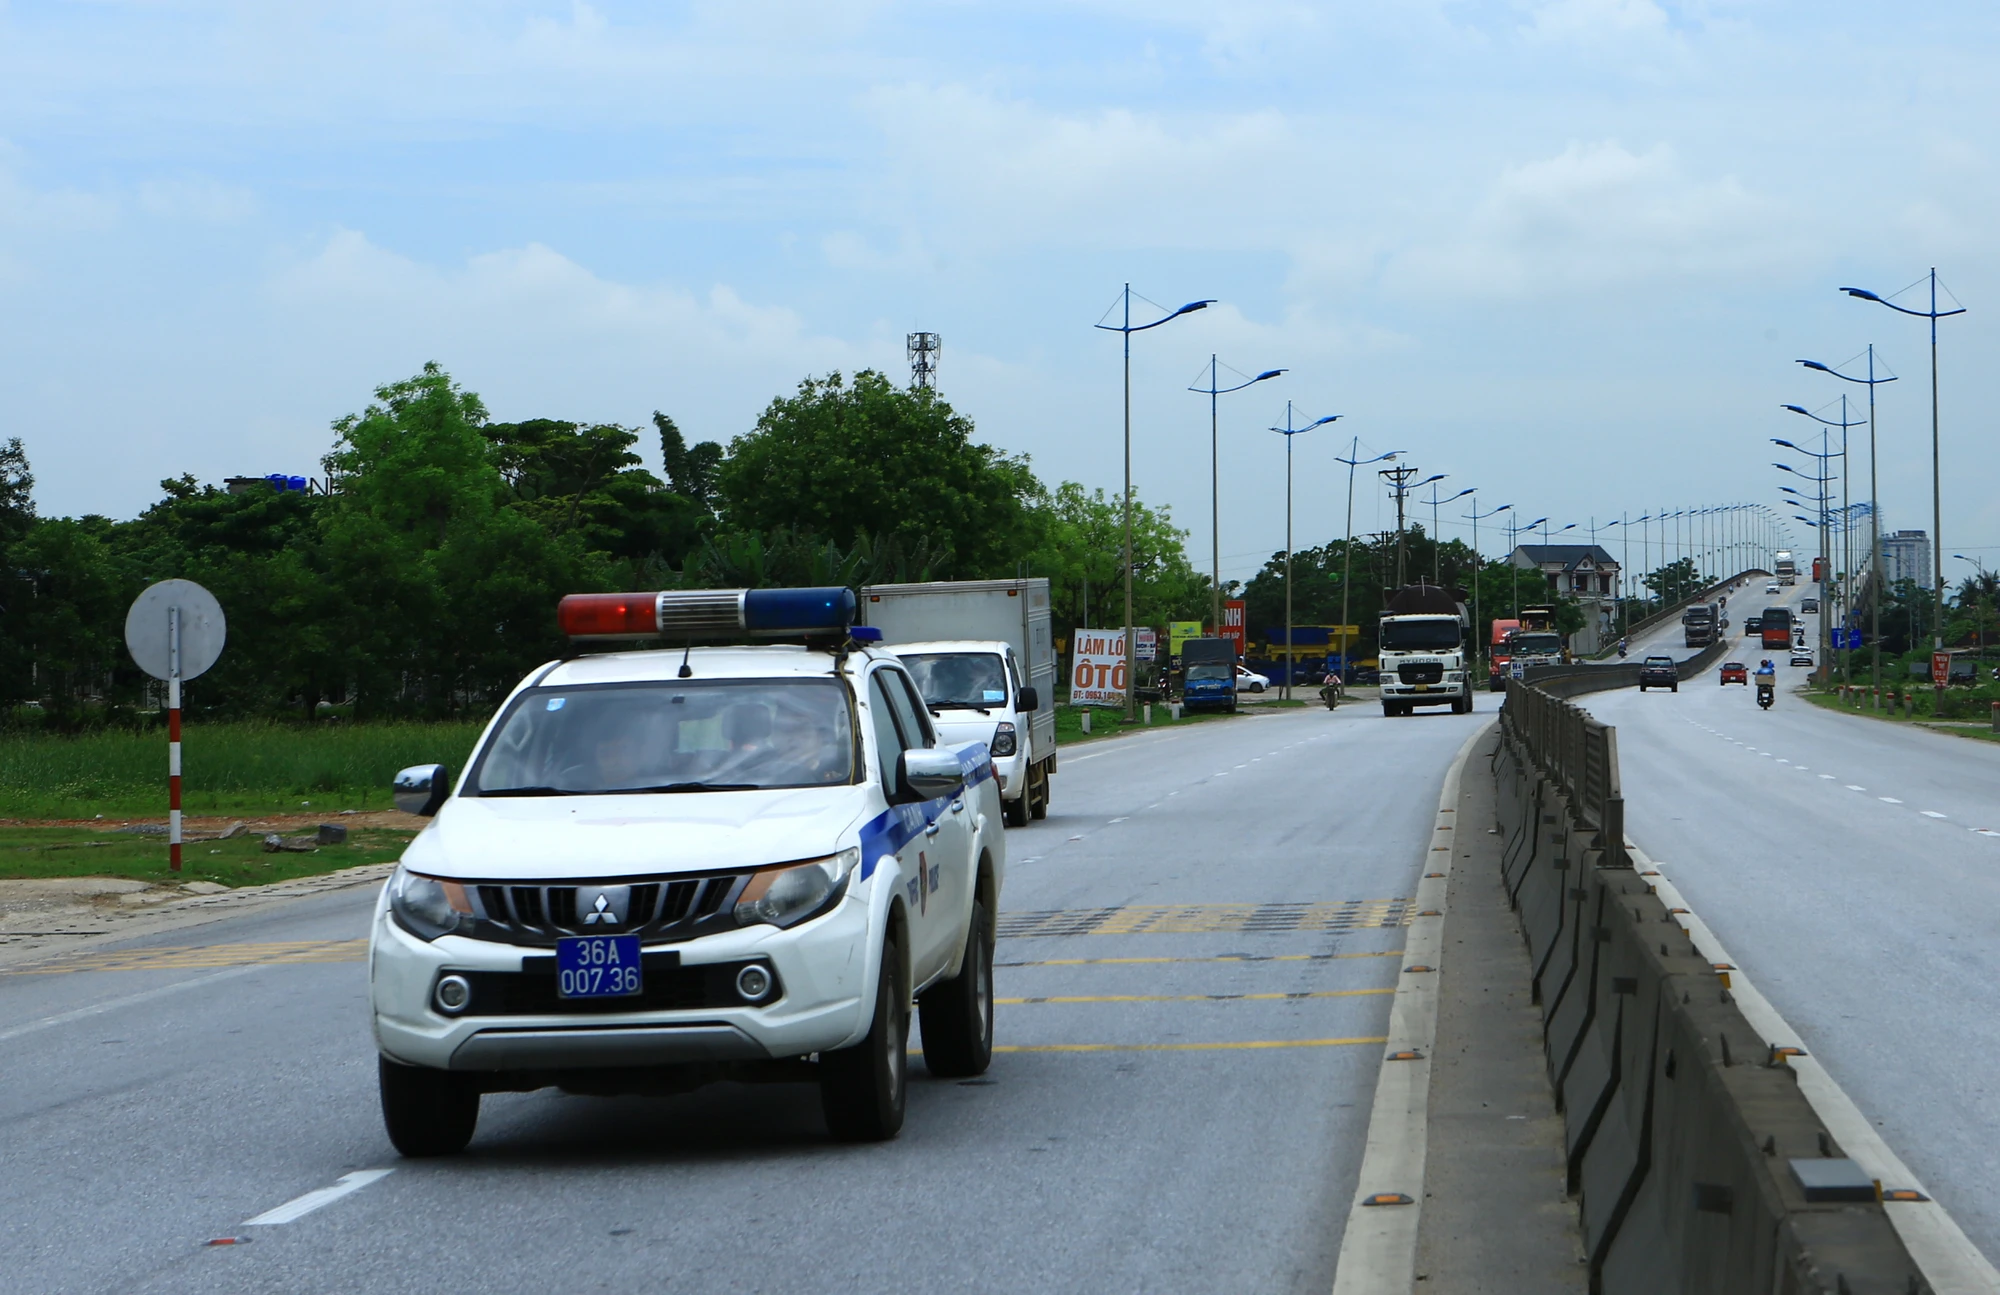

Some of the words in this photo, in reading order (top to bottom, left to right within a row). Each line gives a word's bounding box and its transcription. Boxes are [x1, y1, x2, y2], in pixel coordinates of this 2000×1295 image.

[1077, 634, 1105, 655] LÀM
[1108, 633, 1126, 656] LỐ
[1075, 658, 1127, 690] ÔTÔ
[576, 939, 620, 966] 36A
[561, 967, 638, 994] 007.36
